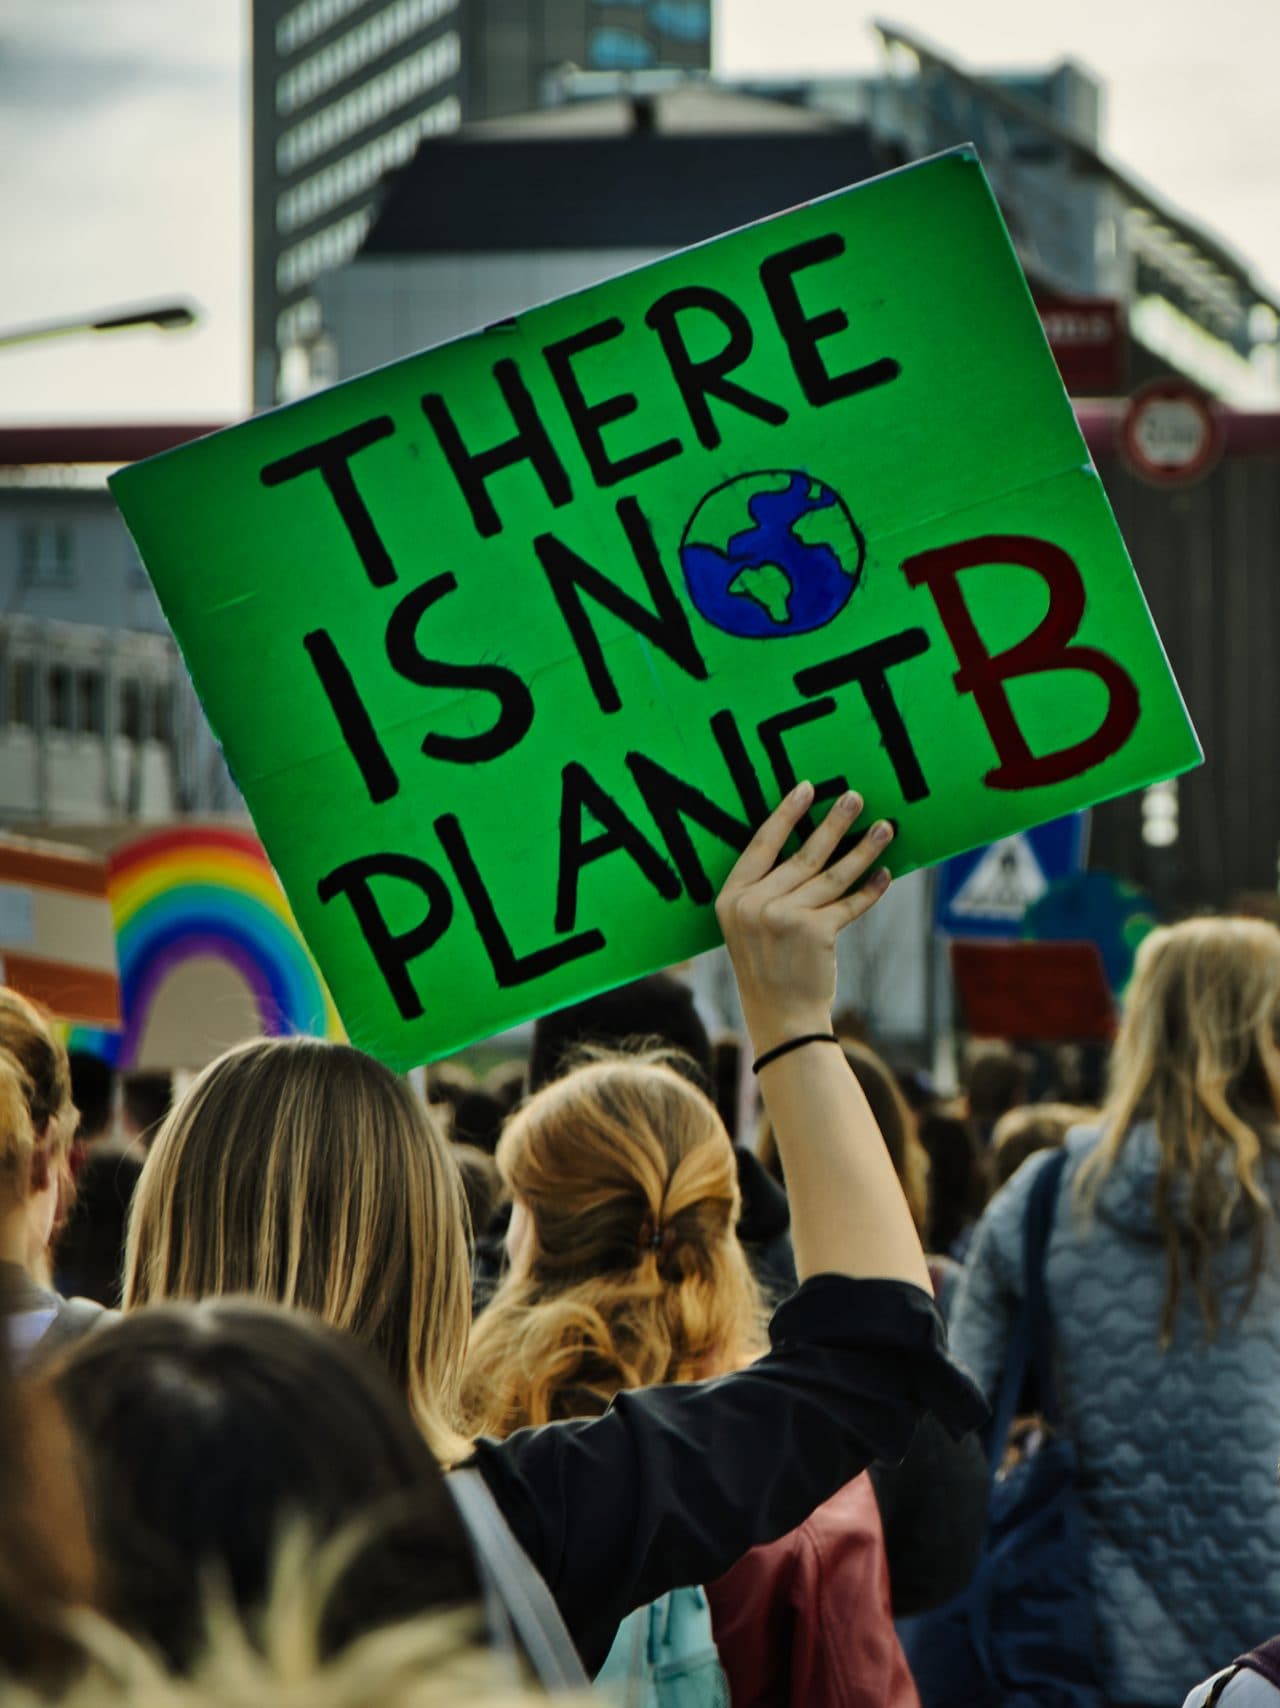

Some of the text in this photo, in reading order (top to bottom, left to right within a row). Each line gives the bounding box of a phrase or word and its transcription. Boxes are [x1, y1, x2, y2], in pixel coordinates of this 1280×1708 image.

[260, 233, 901, 588] THERE
[303, 571, 535, 805] IS
[317, 534, 1142, 1021] PLANET B
